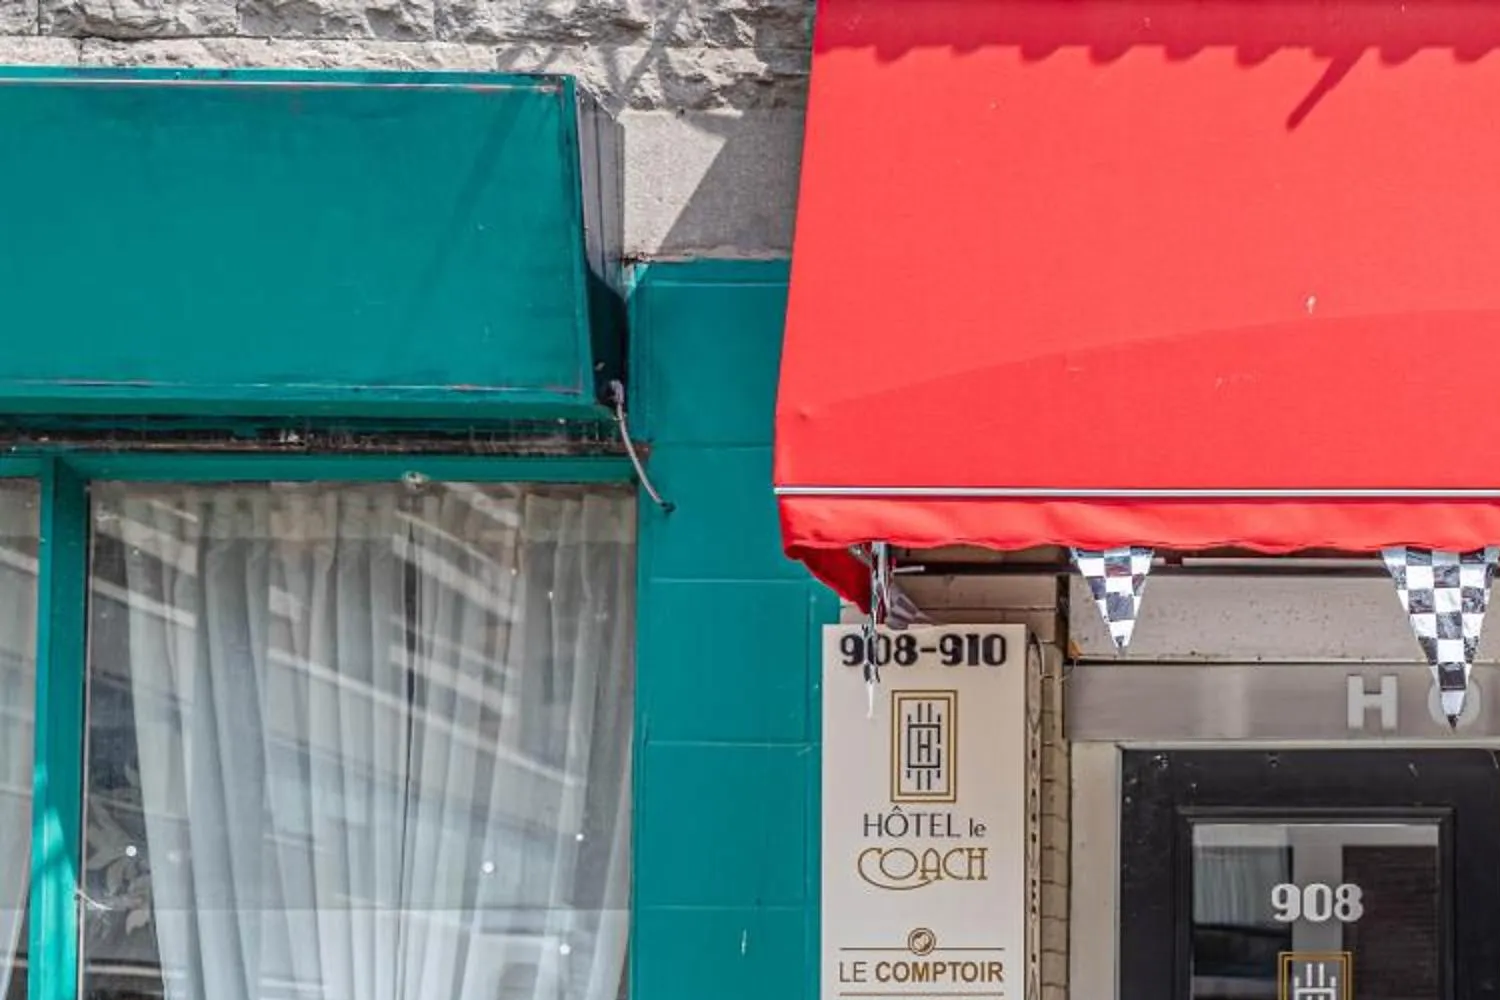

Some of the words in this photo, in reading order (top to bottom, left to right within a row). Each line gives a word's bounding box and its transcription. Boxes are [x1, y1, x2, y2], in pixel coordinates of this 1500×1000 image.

[840, 633, 1007, 667] 908-910
[862, 805, 961, 838] HÔTEL
[968, 817, 987, 838] le
[857, 847, 988, 891] COACH
[1270, 883, 1364, 922] 908
[838, 961, 867, 983] LE
[875, 961, 1004, 983] COMPTOIR
